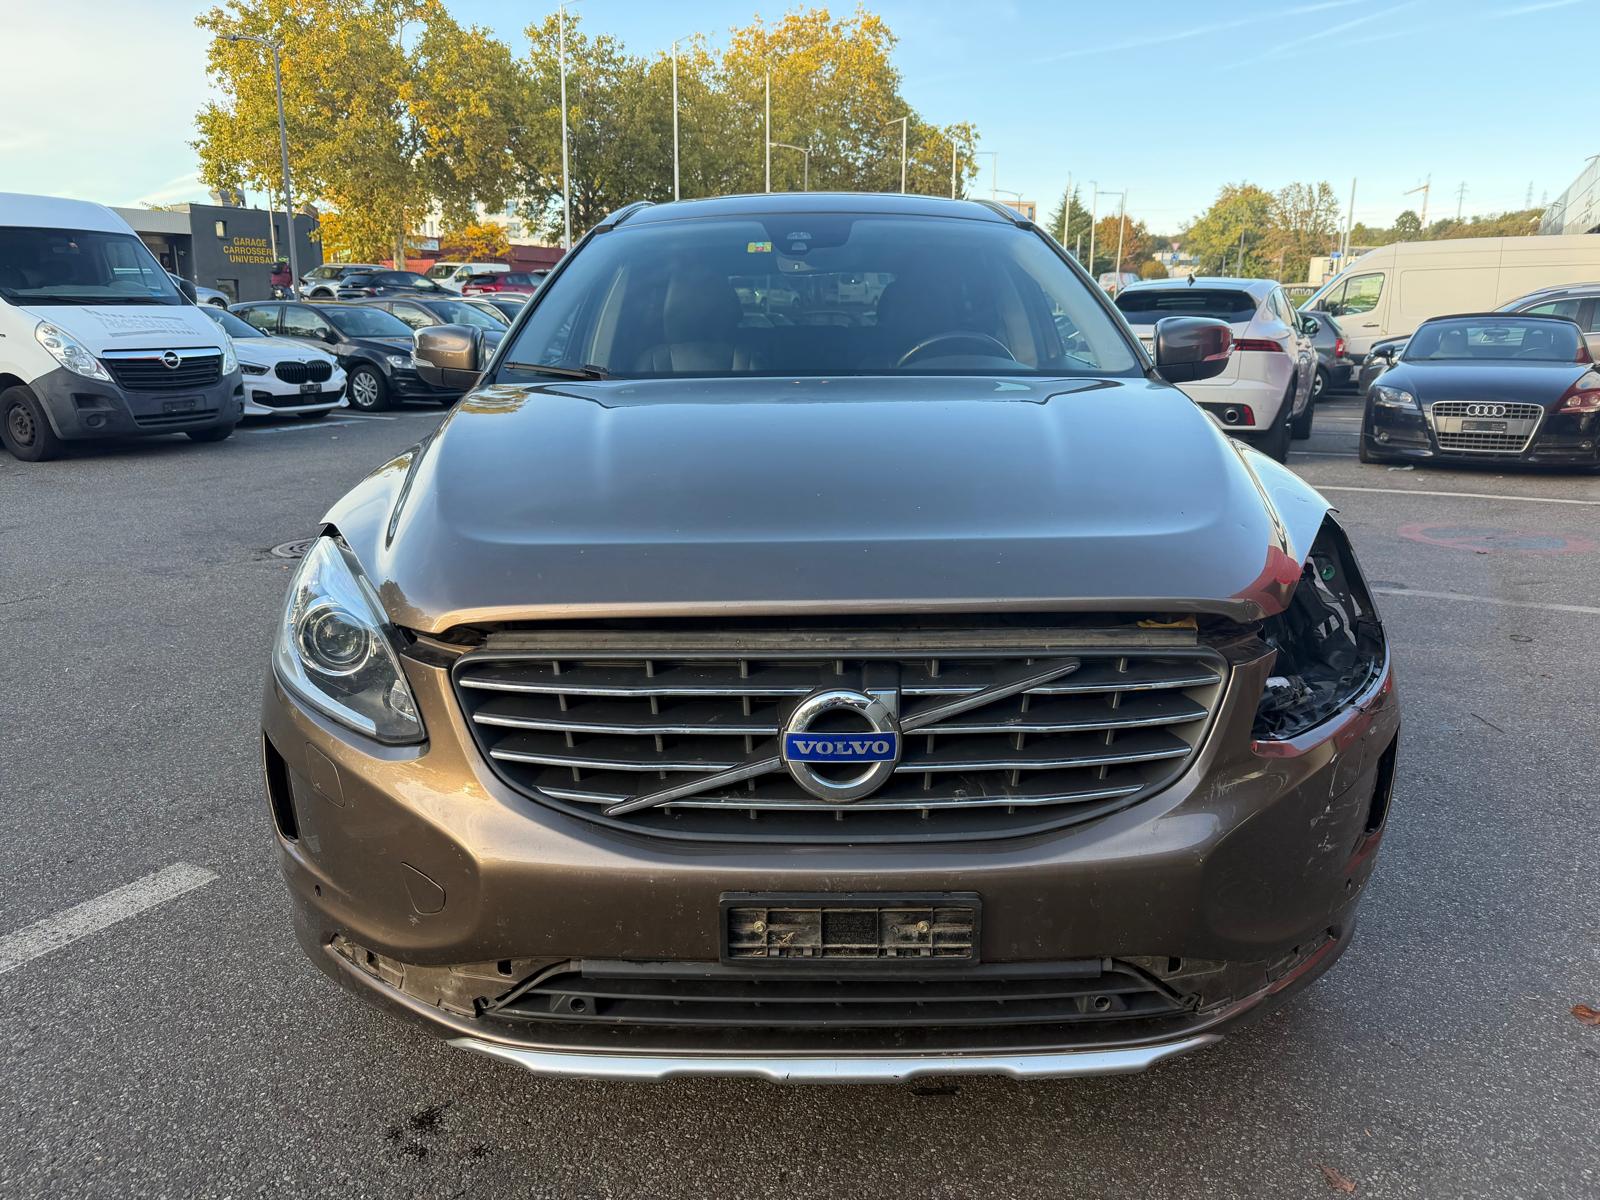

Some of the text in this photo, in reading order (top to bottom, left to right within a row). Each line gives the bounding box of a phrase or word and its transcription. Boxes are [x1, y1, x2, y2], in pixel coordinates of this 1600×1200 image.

[233, 237, 267, 247] GARAGE
[230, 255, 275, 264] UNIVERSAL
[793, 740, 890, 755] VOLVO
